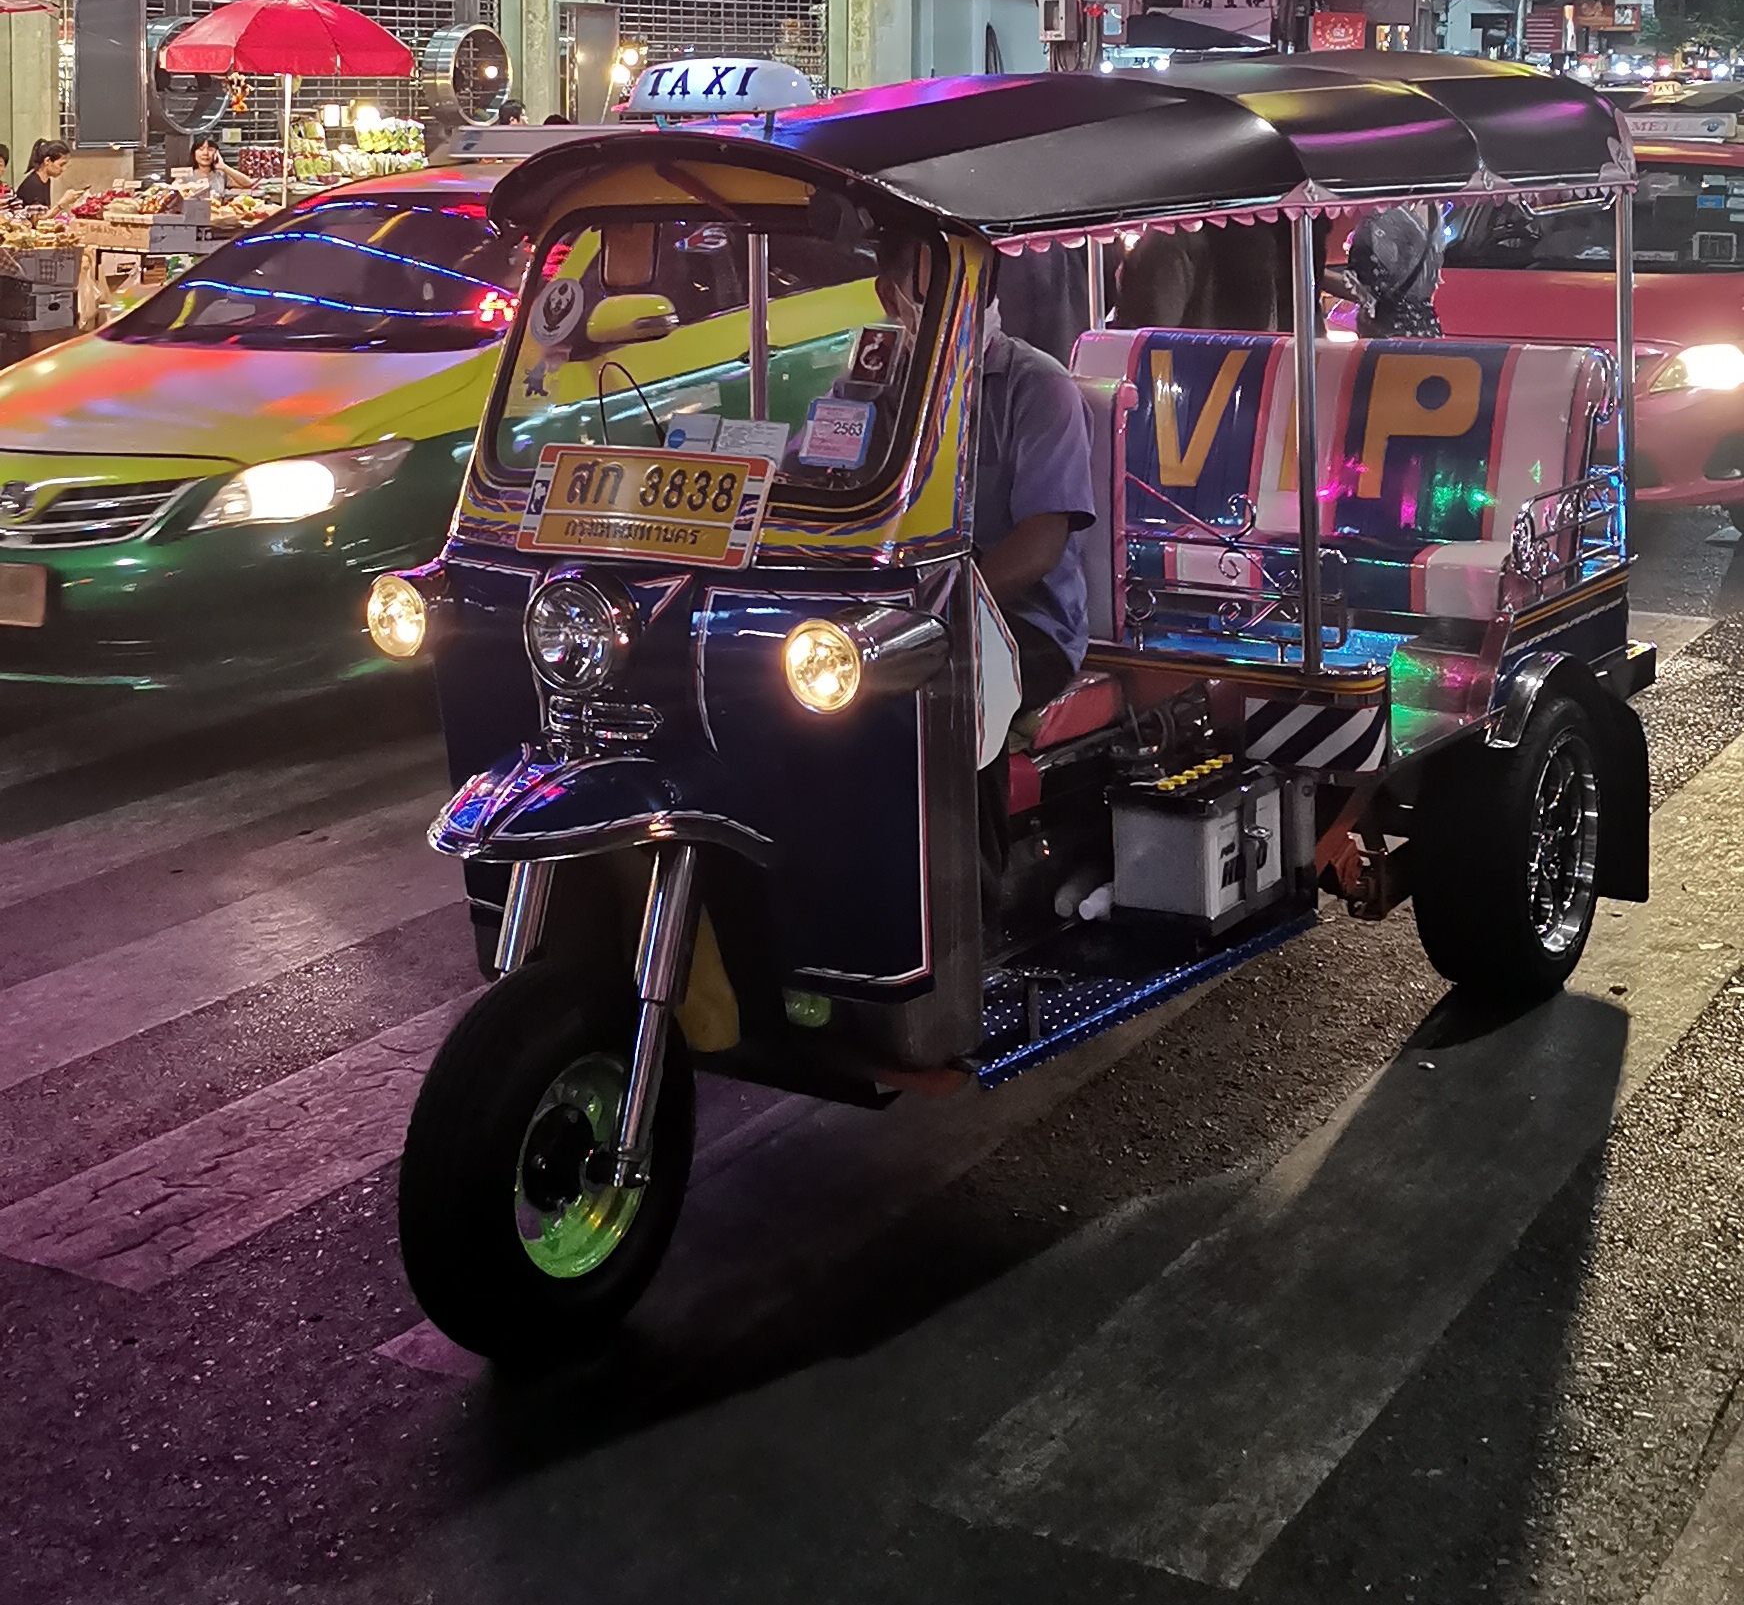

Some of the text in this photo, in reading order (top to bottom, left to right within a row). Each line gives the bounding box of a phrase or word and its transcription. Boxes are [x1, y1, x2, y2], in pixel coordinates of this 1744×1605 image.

[648, 66, 758, 96] TAXI
[834, 421, 863, 437] 2563
[639, 463, 738, 513] 3838
